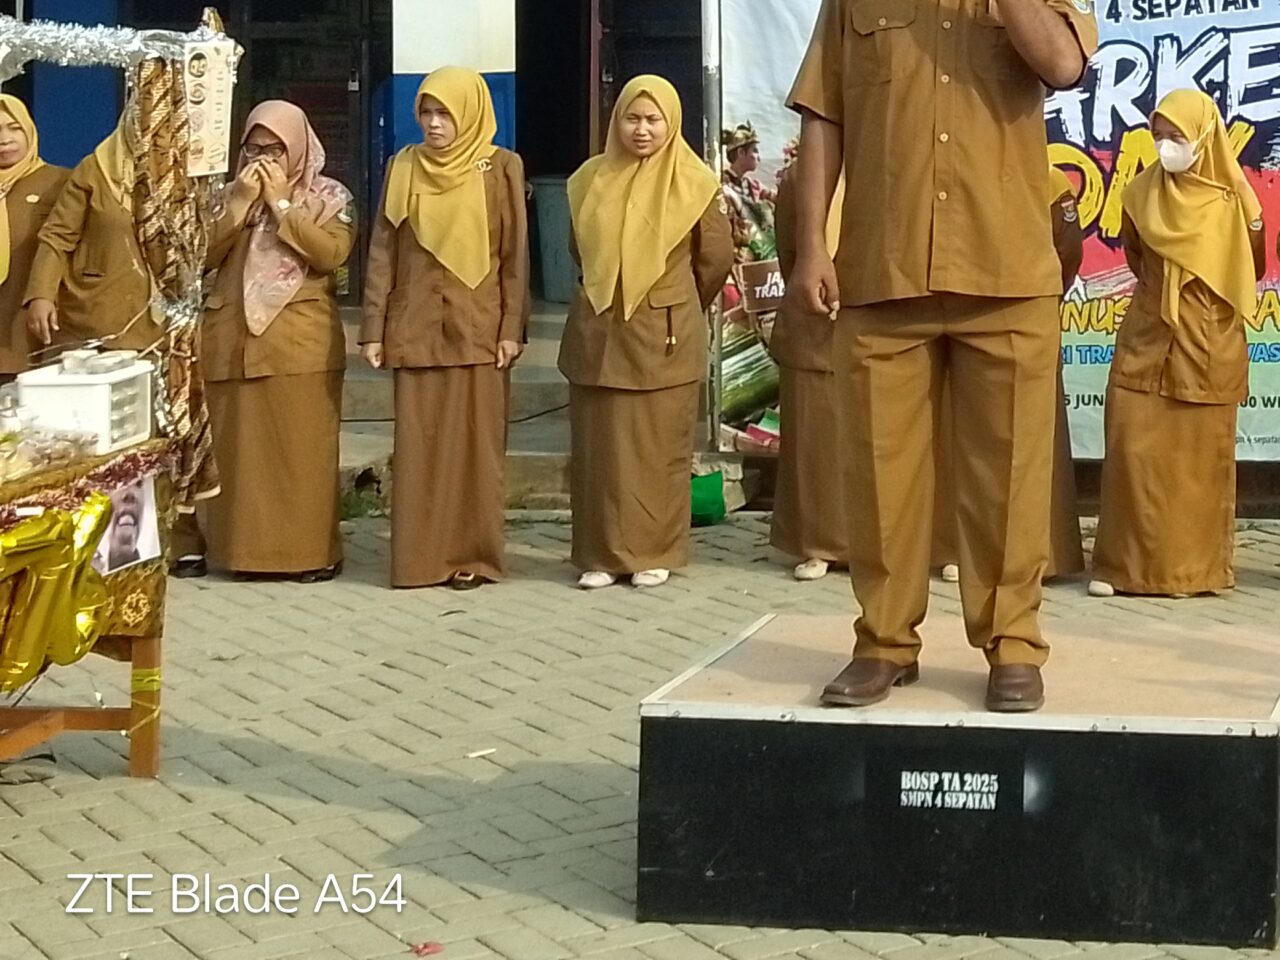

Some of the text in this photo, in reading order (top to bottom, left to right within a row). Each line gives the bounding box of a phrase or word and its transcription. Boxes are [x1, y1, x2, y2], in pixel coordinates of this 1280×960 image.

[900, 771, 999, 793] BOSP TA 2025
[900, 790, 997, 810] SMPN 4 SEPATAN
